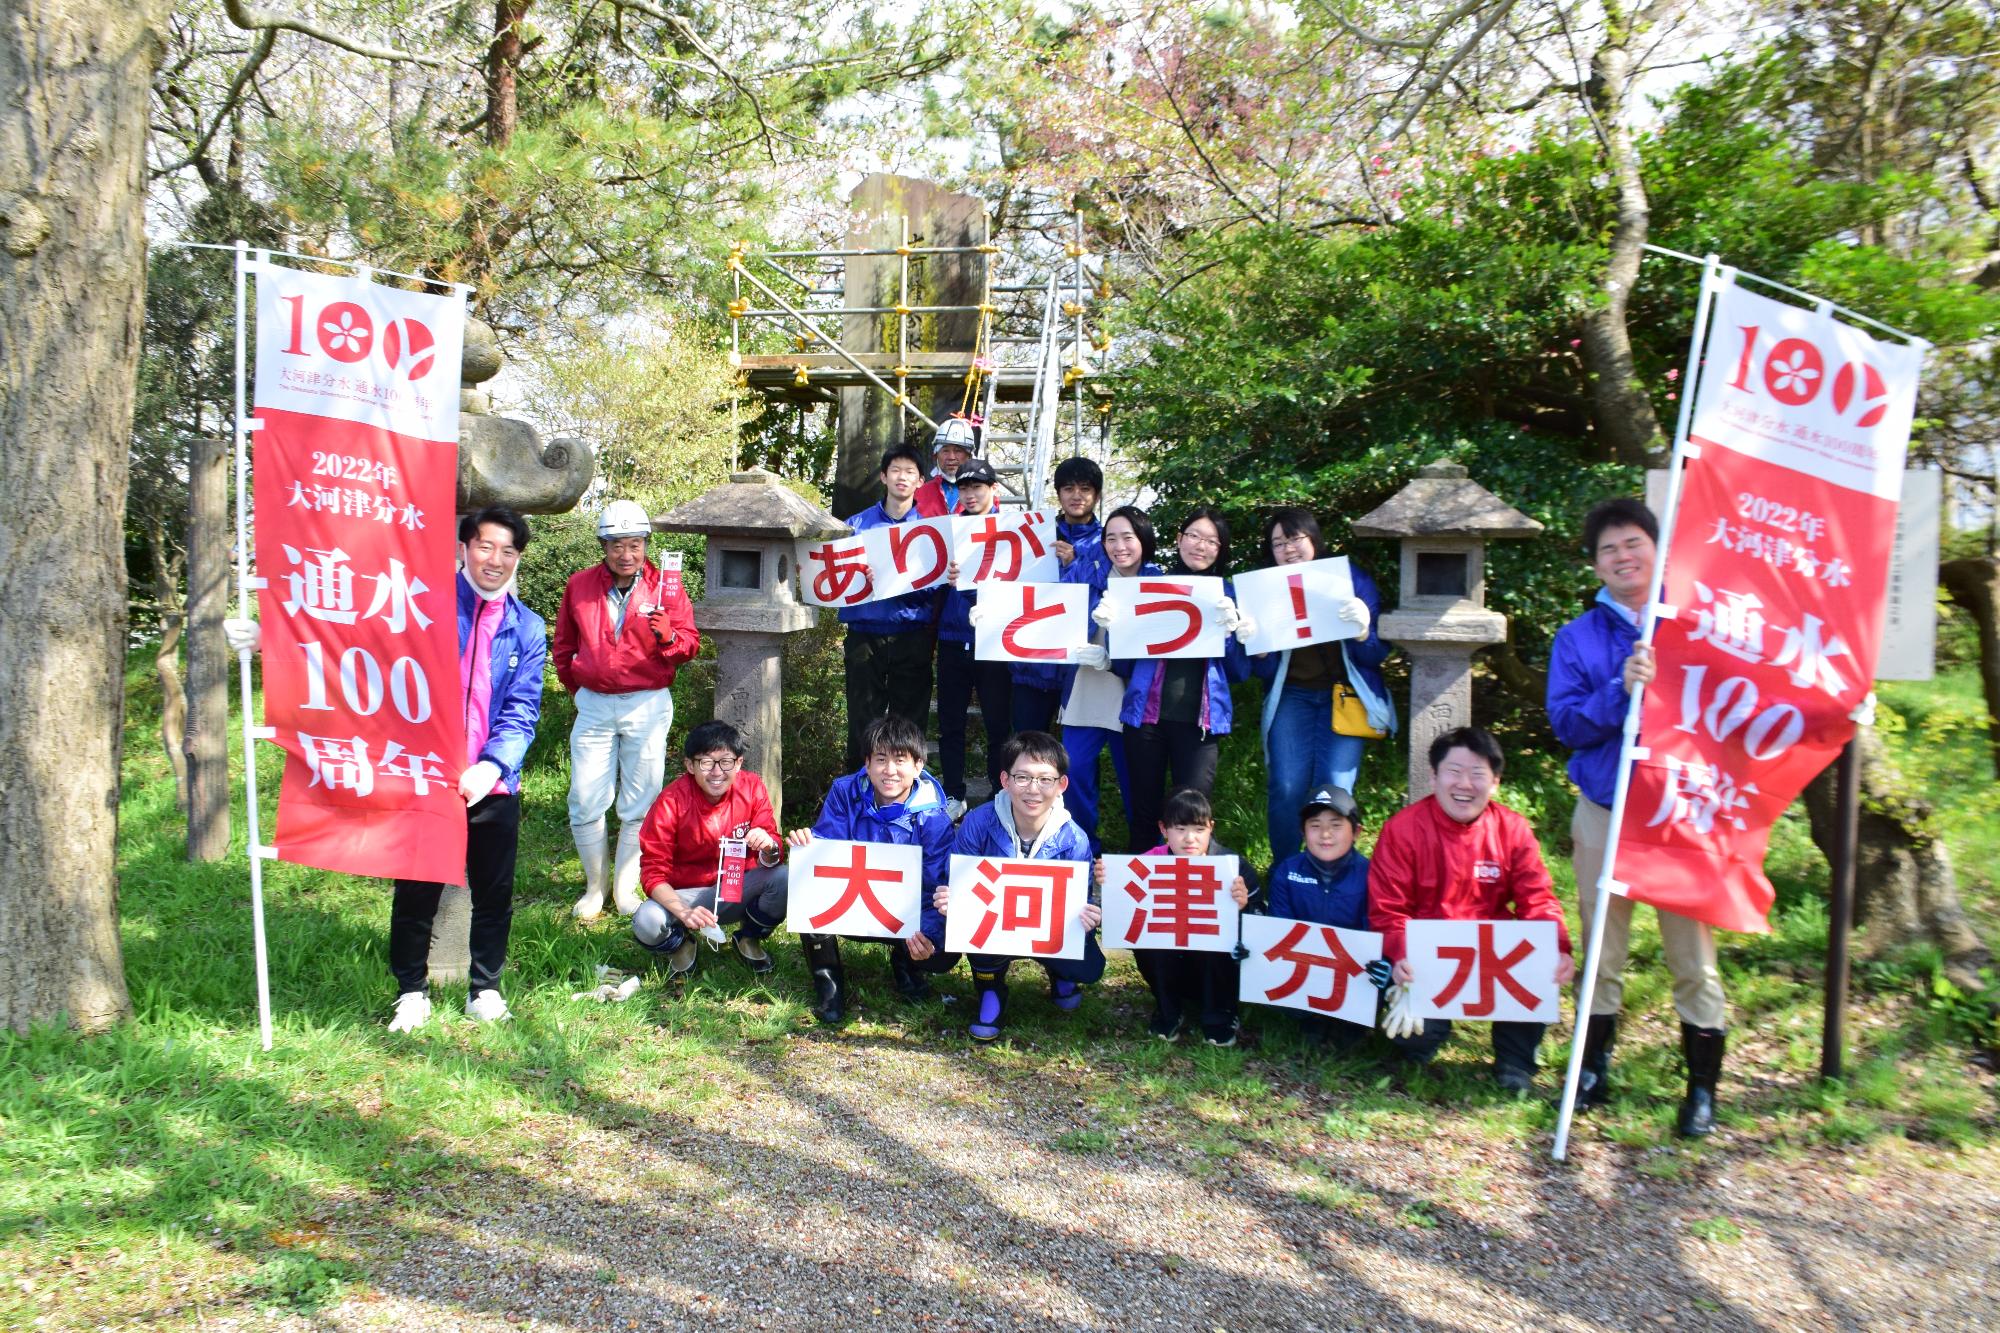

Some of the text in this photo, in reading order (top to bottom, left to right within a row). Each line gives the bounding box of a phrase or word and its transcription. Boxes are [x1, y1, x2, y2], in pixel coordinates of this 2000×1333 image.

[286, 480, 426, 531] 大河津分水
[312, 450, 398, 490] 2022年
[1704, 517, 1851, 587] 大河津分水
[1738, 492, 1825, 542] 2022年
[281, 543, 434, 634] 通水
[1001, 585, 1067, 660] と
[1134, 582, 1203, 656] う
[1687, 580, 1850, 698] 通水
[298, 641, 432, 724] 100
[1674, 664, 1804, 761] 100
[297, 731, 449, 798] 周年
[809, 845, 904, 933] 大
[969, 858, 1075, 955] 河
[1123, 856, 1224, 948] 津
[1264, 923, 1362, 1011] 分
[1433, 924, 1541, 1016] 水
